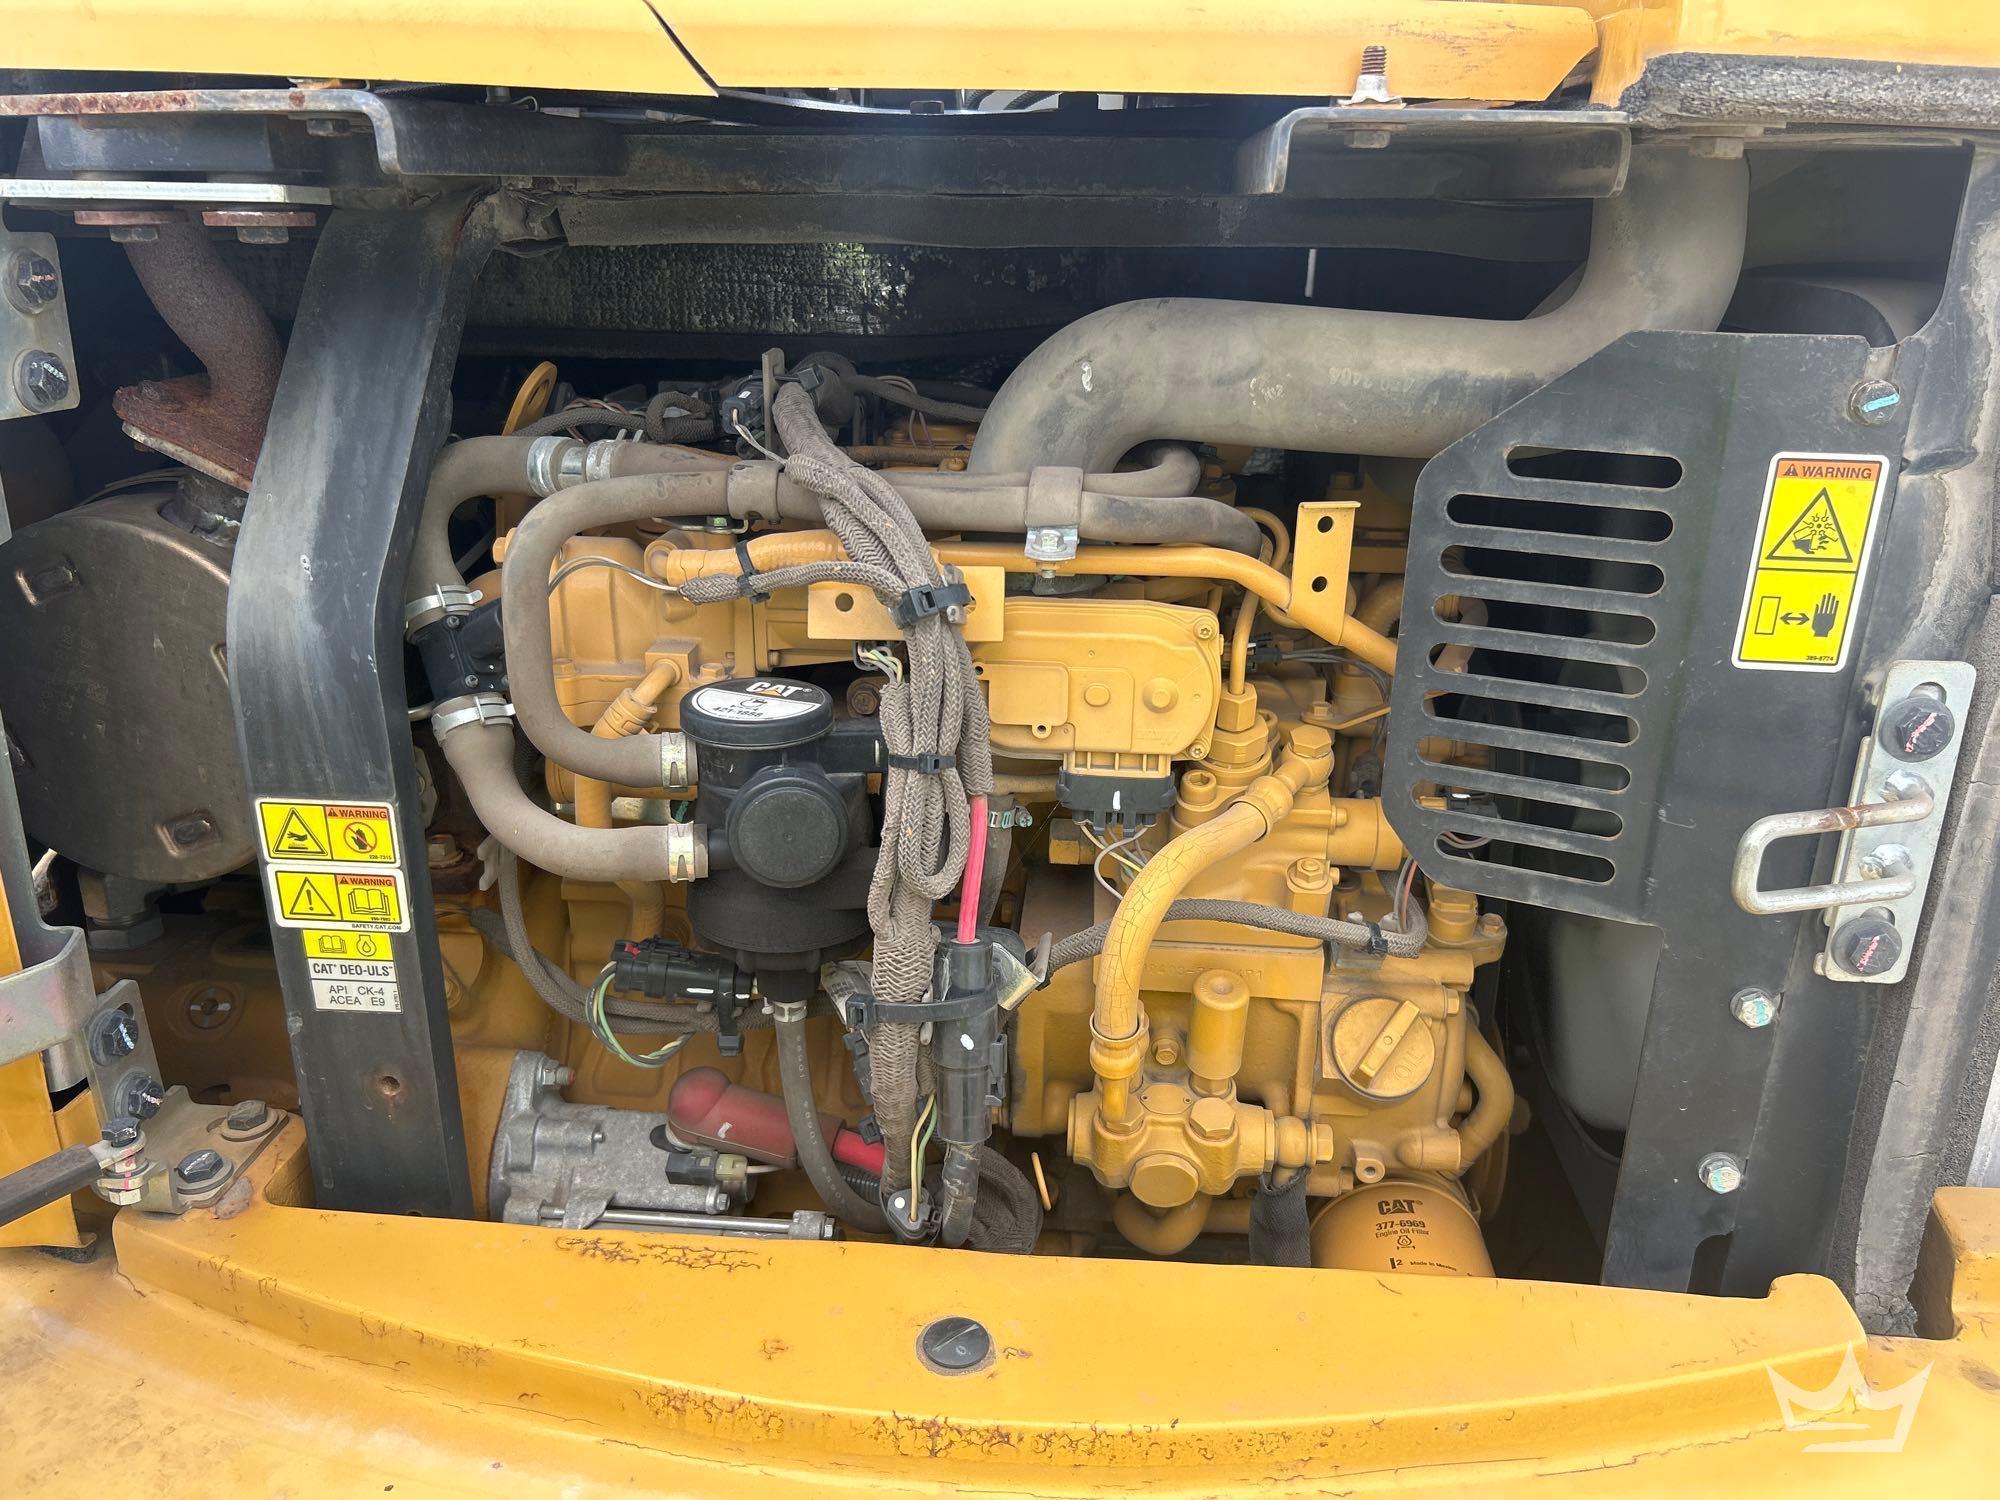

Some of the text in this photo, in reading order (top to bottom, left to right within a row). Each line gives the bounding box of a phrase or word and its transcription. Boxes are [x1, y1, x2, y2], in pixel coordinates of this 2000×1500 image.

[1802, 466, 1871, 479] WARNING
[338, 809, 387, 819] WARNING
[350, 877, 393, 887] WARNING
[329, 985, 385, 996] API CK-4
[330, 996, 362, 1006] ACEA
[371, 997, 385, 1007] E9
[1375, 1220, 1426, 1230] 377-6969
[1375, 1229, 1399, 1239] Engine
